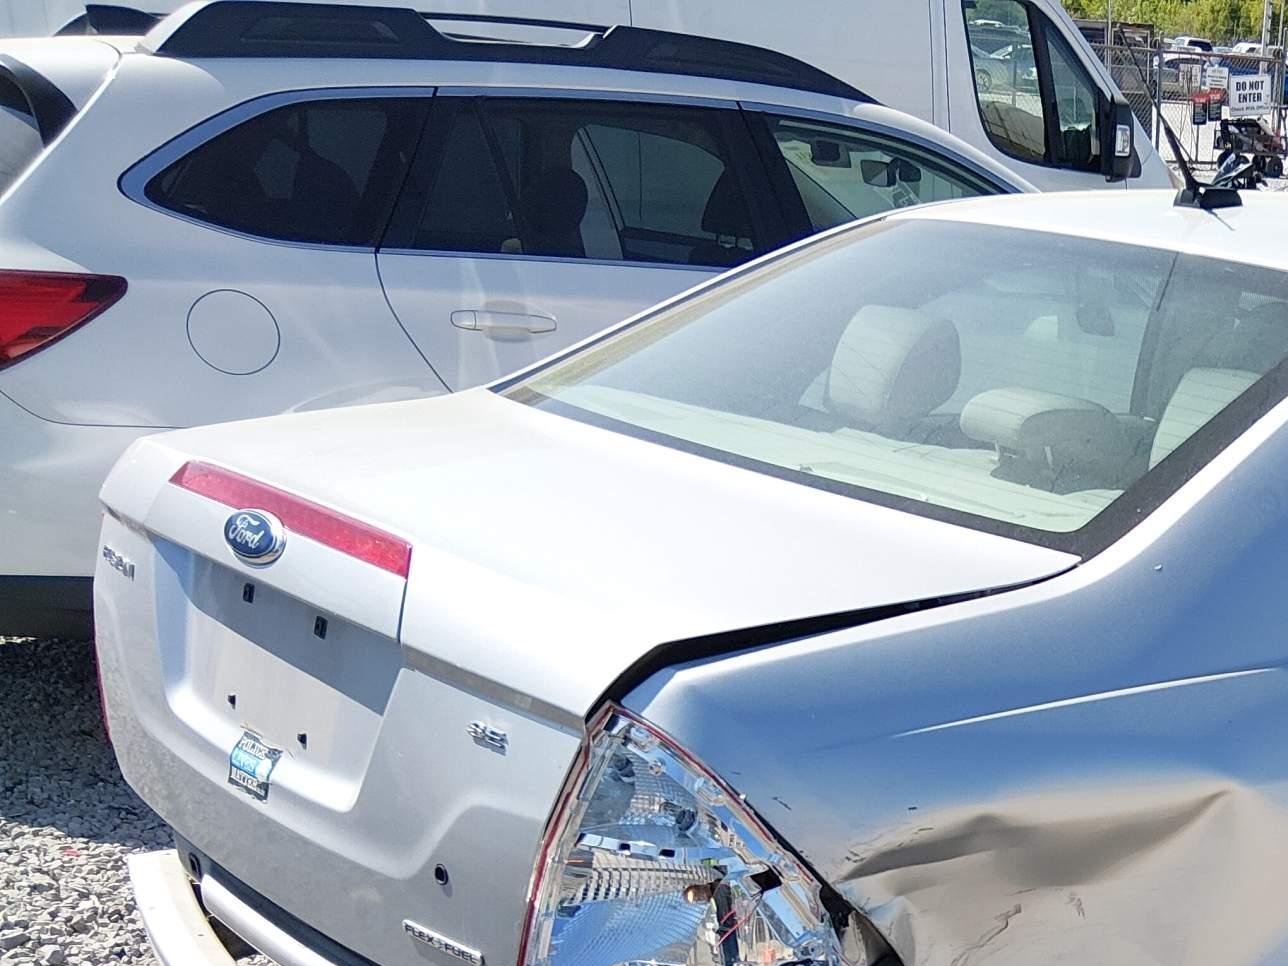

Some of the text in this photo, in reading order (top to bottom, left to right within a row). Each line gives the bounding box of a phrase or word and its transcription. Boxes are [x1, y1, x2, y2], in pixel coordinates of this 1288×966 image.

[1236, 80, 1264, 91] DO NOT
[1238, 92, 1263, 103] ENTER
[228, 514, 265, 549] Ford
[404, 923, 480, 965] FLEX FUEL
